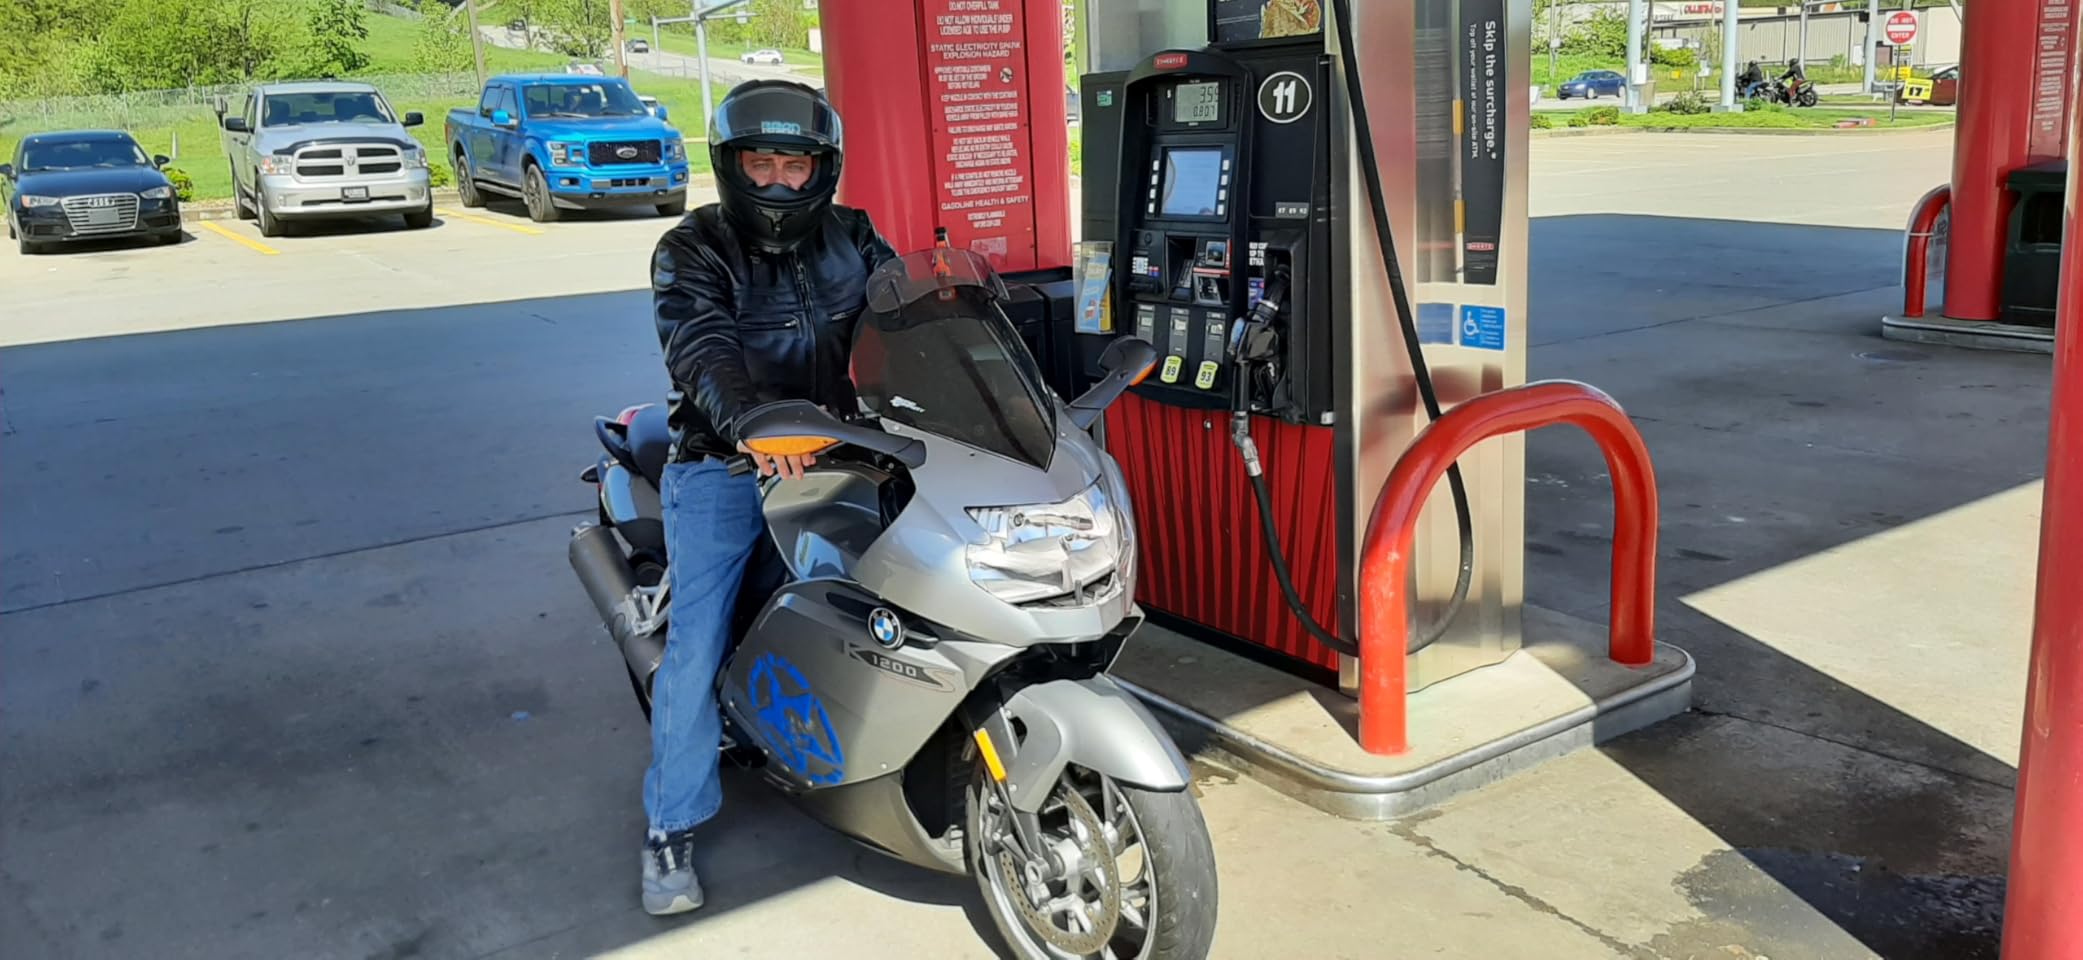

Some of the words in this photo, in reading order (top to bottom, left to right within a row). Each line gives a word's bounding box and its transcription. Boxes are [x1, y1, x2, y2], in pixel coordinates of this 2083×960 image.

[1469, 23, 1477, 38] Top
[1483, 20, 1497, 51] Skip
[1890, 31, 1910, 39] ENTER
[930, 43, 954, 52] STATIC
[955, 42, 998, 52] ELECTRICITY
[943, 51, 982, 60] EXPLOSION
[982, 50, 1010, 58] HAZARD
[1485, 54, 1497, 77] the
[1273, 80, 1297, 114] 11
[941, 200, 974, 210] GASOLINE
[974, 197, 1000, 207] HEALTH
[1201, 370, 1212, 382] 93
[870, 654, 918, 678] 1200
